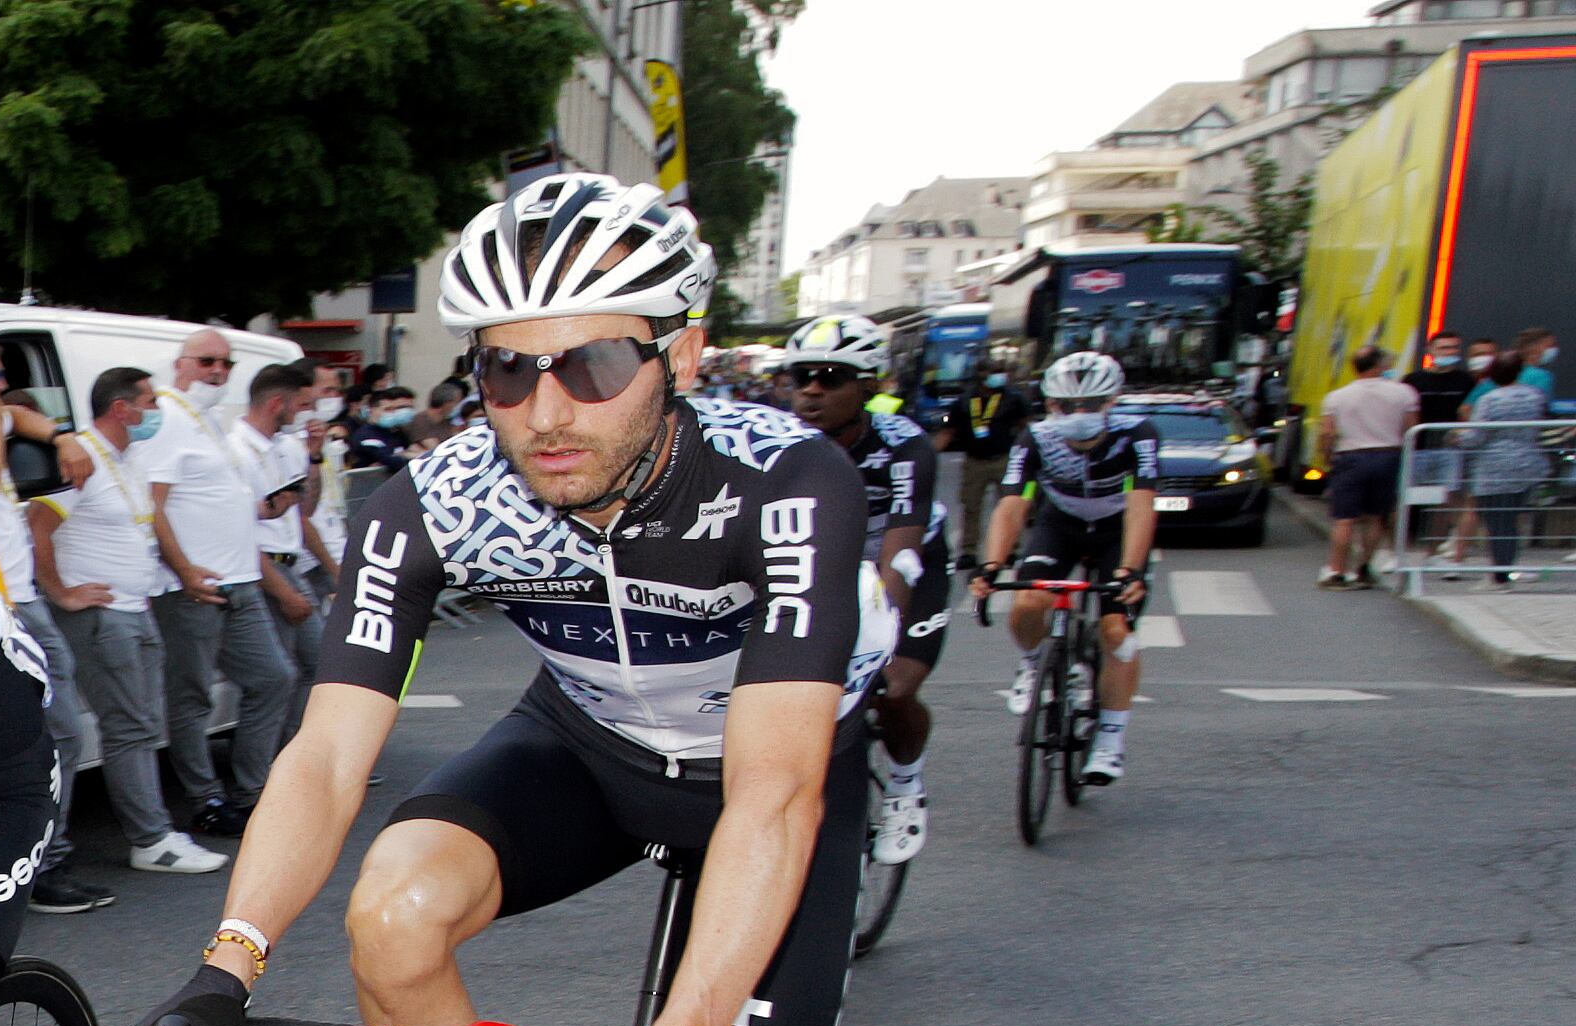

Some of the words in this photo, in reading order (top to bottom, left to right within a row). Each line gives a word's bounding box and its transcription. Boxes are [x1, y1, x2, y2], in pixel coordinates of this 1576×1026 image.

[890, 460, 916, 515] BMC
[344, 519, 410, 656] BMC
[468, 579, 595, 594] BURBERRY
[760, 496, 818, 638] BMC
[625, 582, 736, 622] Qhubeka
[527, 615, 754, 649] NEXTHAS
